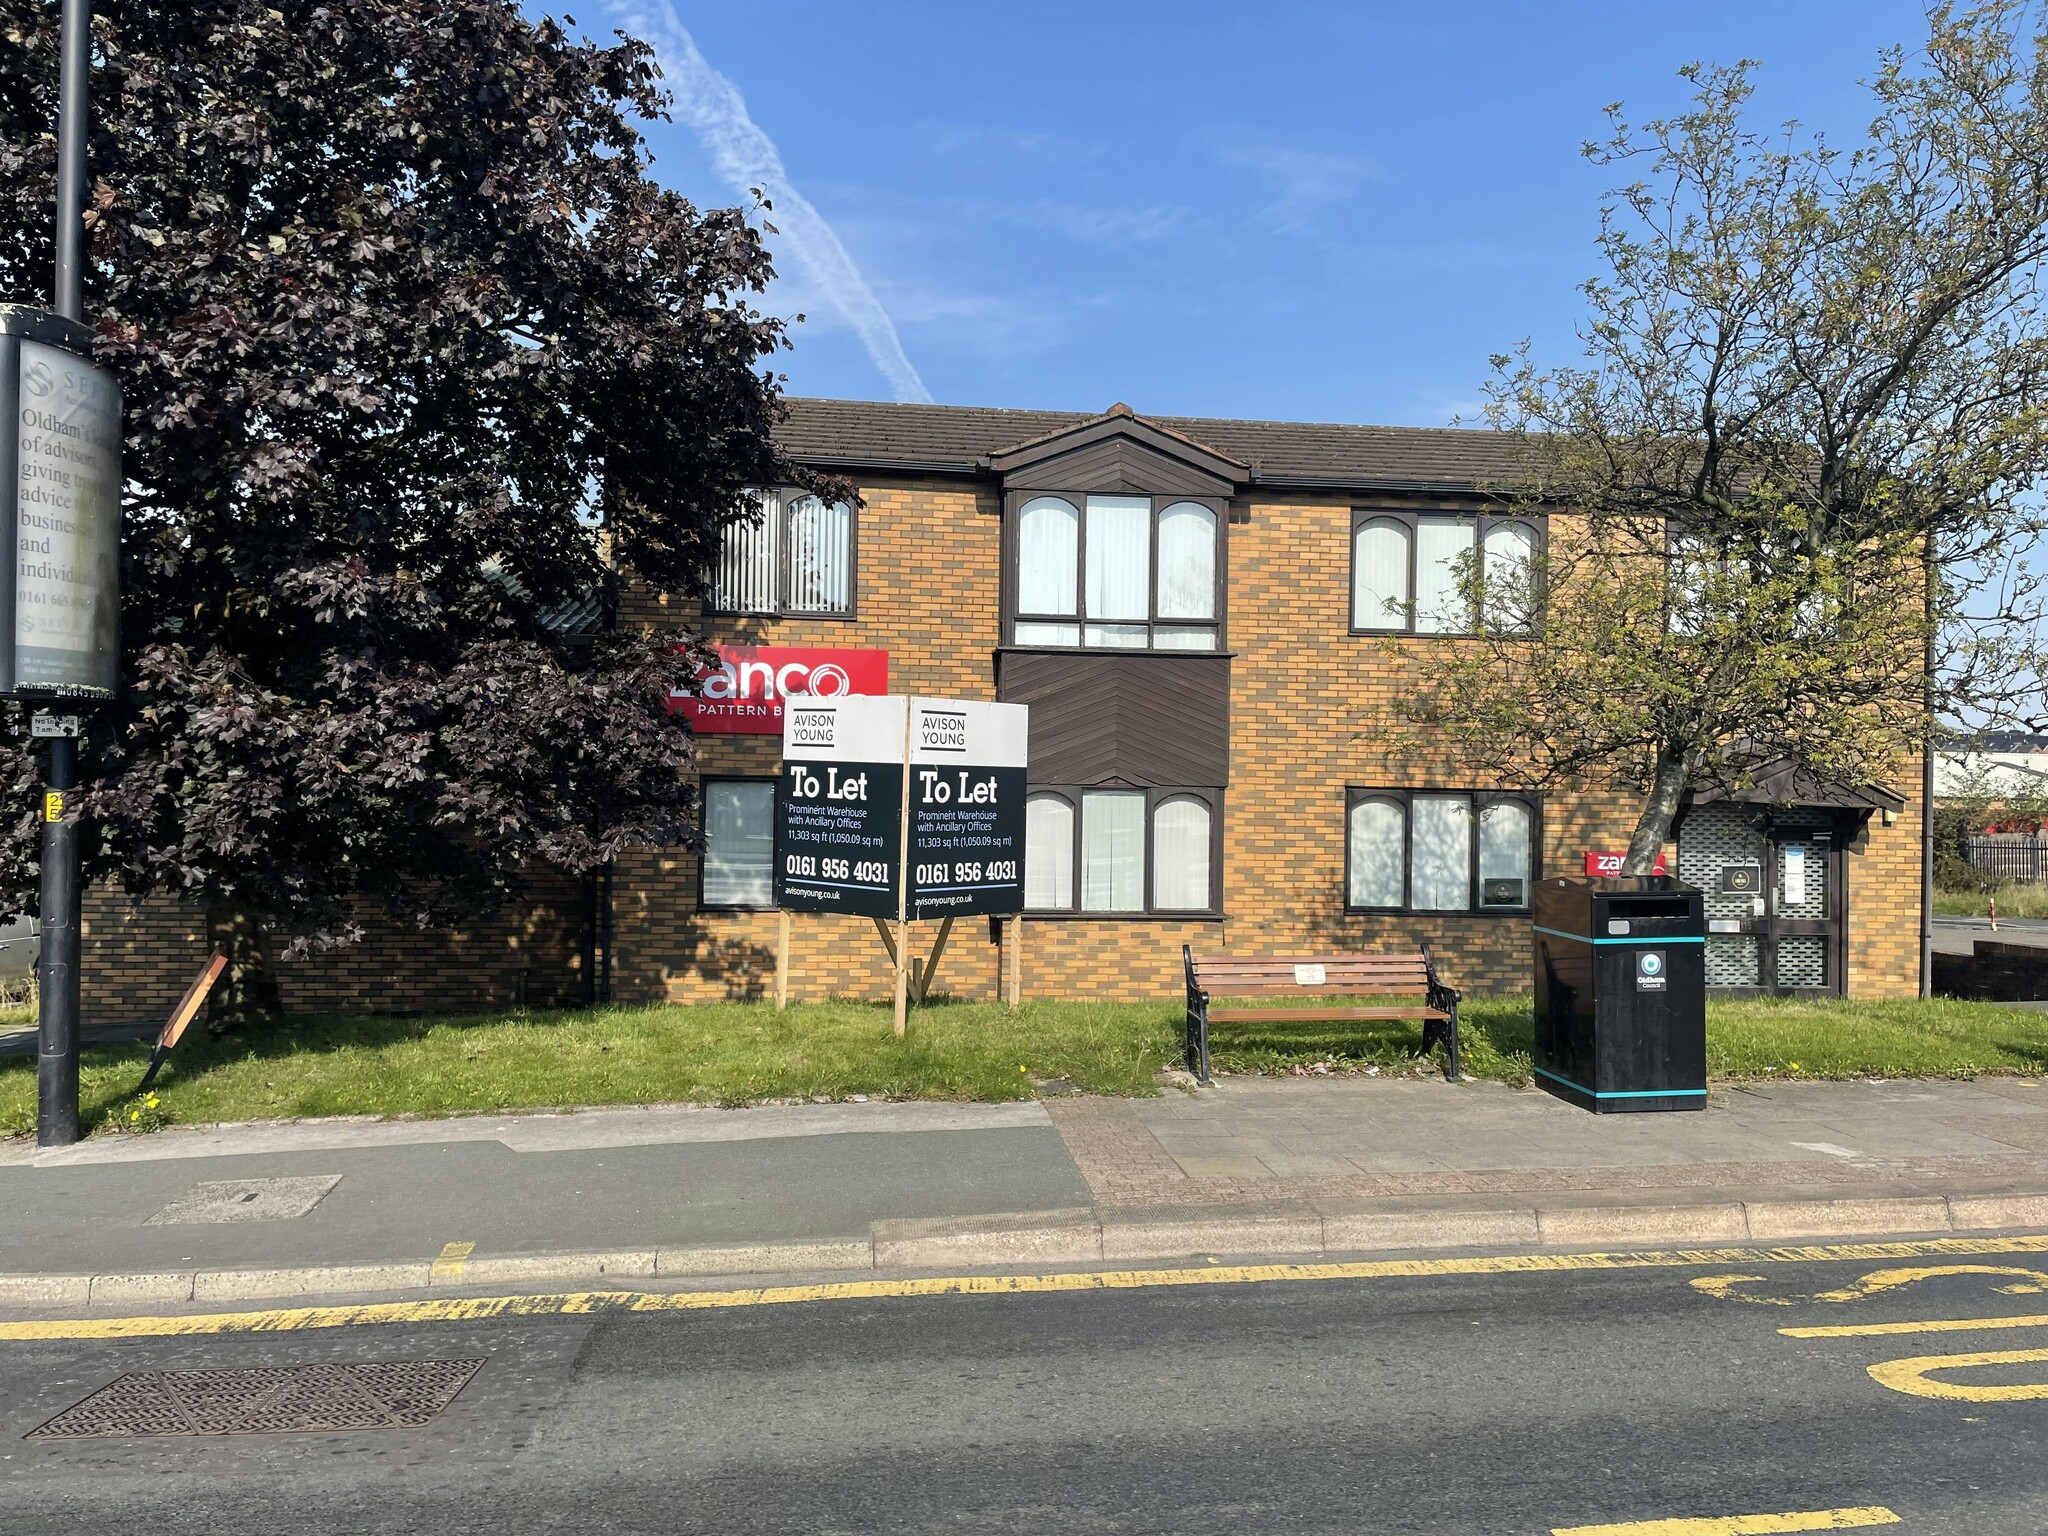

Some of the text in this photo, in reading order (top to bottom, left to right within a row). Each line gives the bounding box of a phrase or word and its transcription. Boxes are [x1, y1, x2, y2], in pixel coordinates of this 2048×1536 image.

[21, 435, 42, 453] of
[21, 459, 70, 489] giving
[20, 485, 71, 509] advice
[20, 537, 51, 554] and
[18, 589, 46, 605] 0161
[698, 704, 767, 716] PATTERN
[793, 715, 835, 727] AVISON
[922, 717, 965, 731] AVISON
[793, 729, 834, 741] YOUNG
[922, 732, 965, 745] YOUNG
[790, 766, 868, 801] To Let
[919, 770, 998, 804] To Let
[788, 804, 868, 818] Prominent Warehouse
[918, 810, 998, 821] Prominent Warehouse
[788, 815, 862, 829] with Ancillary Offices
[917, 820, 992, 834] with Ancillary Offices
[788, 829, 884, 848] 11,303 sq ft (1,050.09 sq m)
[917, 836, 1012, 849] 11,303 sq ft (1,050.09 sq m)
[786, 854, 889, 884] 0161 956 4031
[916, 860, 1017, 885] 0161 956 4031
[785, 886, 841, 900] avisonyoung.co.uk
[914, 894, 973, 906] avisonyoung.co.uk
[1636, 976, 1667, 984] Oldham
